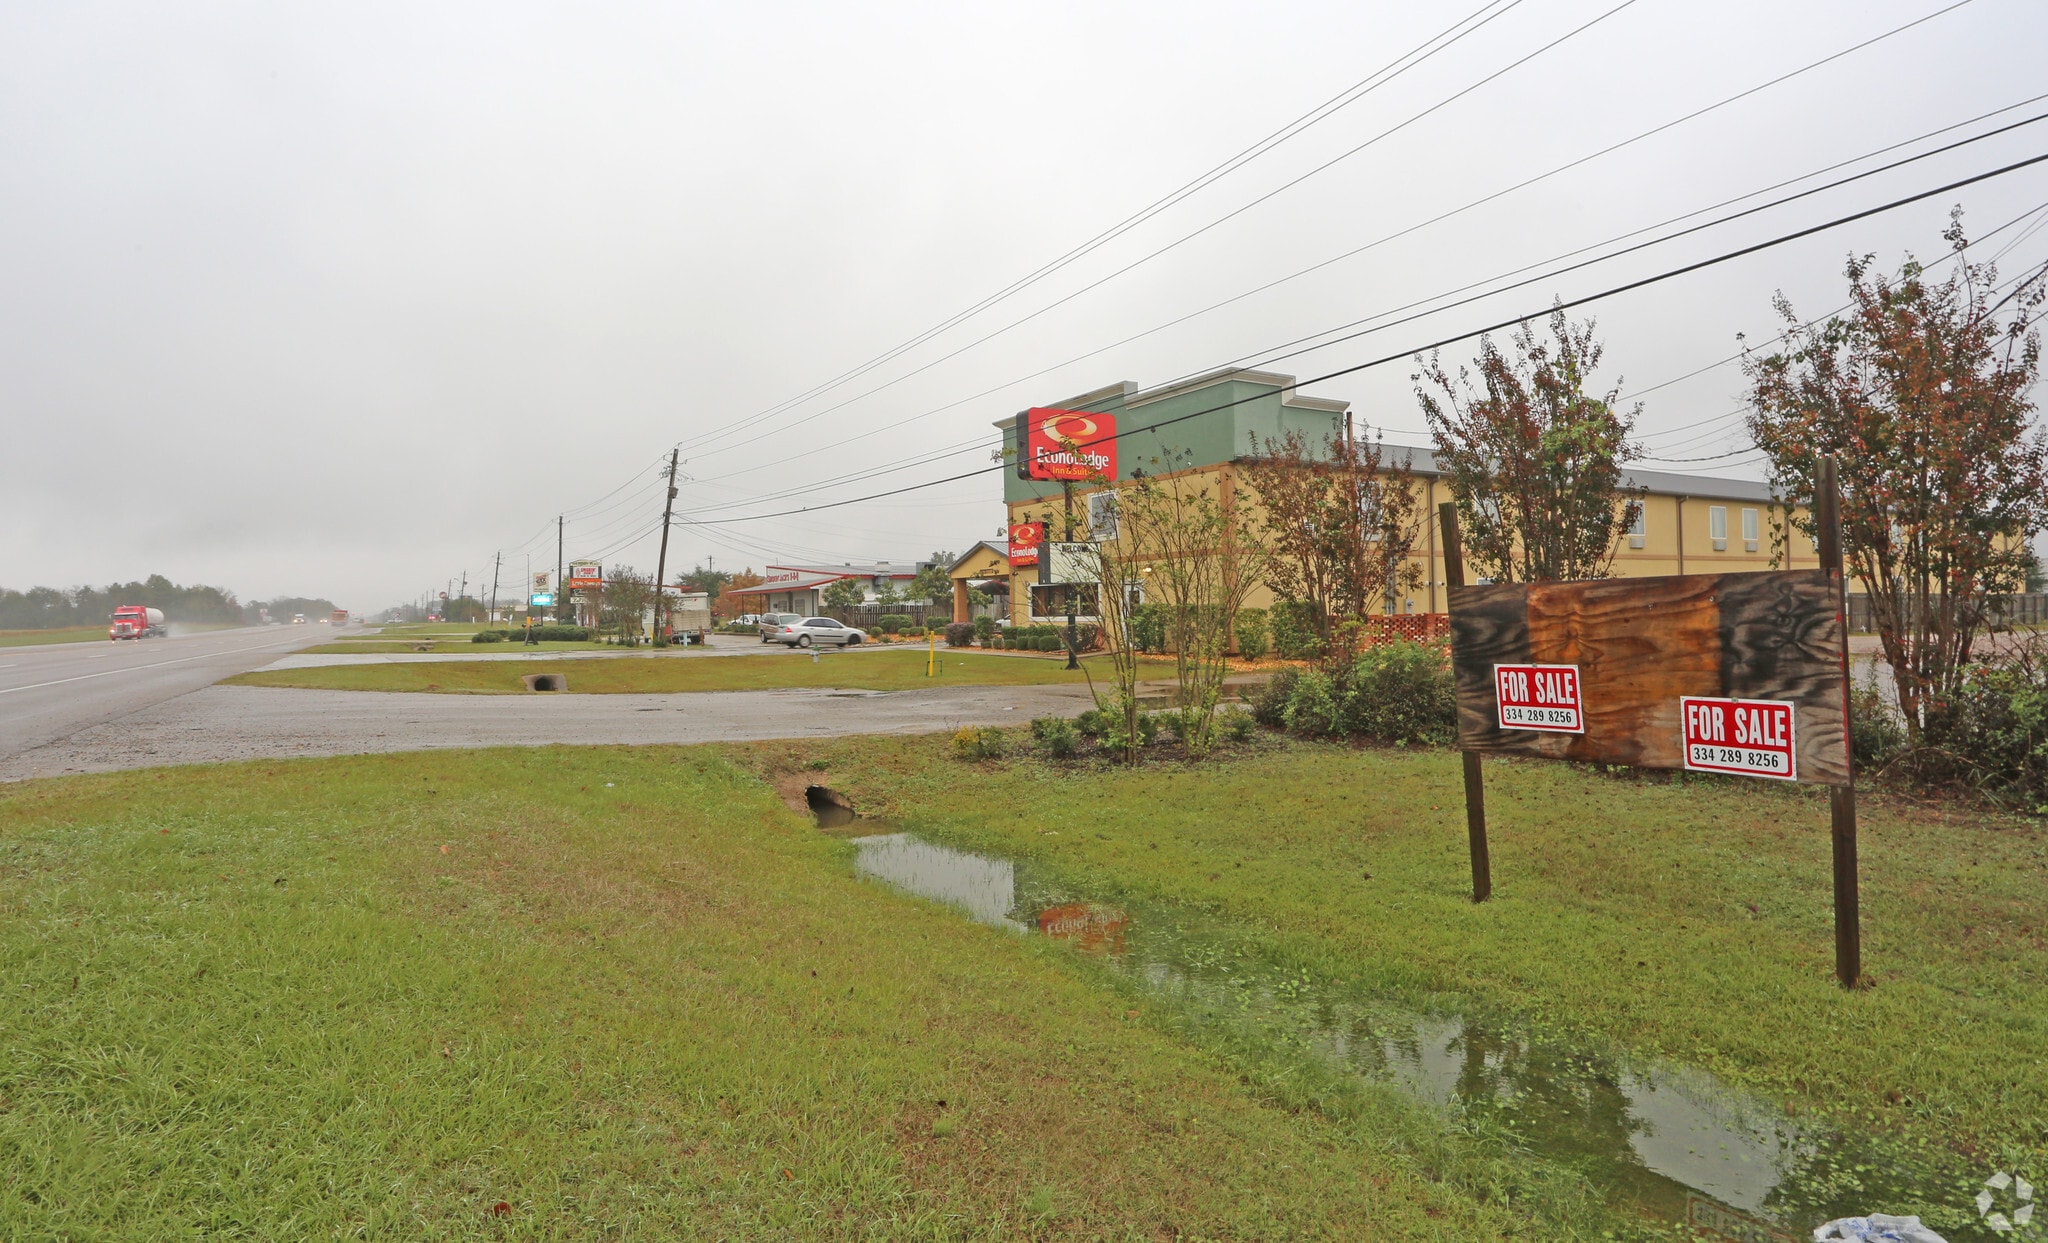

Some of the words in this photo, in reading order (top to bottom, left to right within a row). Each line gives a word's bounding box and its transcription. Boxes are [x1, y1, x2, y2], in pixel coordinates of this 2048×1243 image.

[1052, 466, 1065, 475] Inn
[1011, 546, 1038, 558] EconoLodg
[1500, 671, 1530, 703] FOR
[1534, 672, 1575, 705] SALE
[1505, 708, 1523, 720] 334
[1527, 709, 1544, 722] 289
[1548, 710, 1572, 723] 8256
[1687, 704, 1726, 742] FOR
[1734, 707, 1788, 747] SALE
[1693, 747, 1715, 761] 334
[1719, 749, 1742, 763] 289
[1748, 752, 1779, 768] 8256
